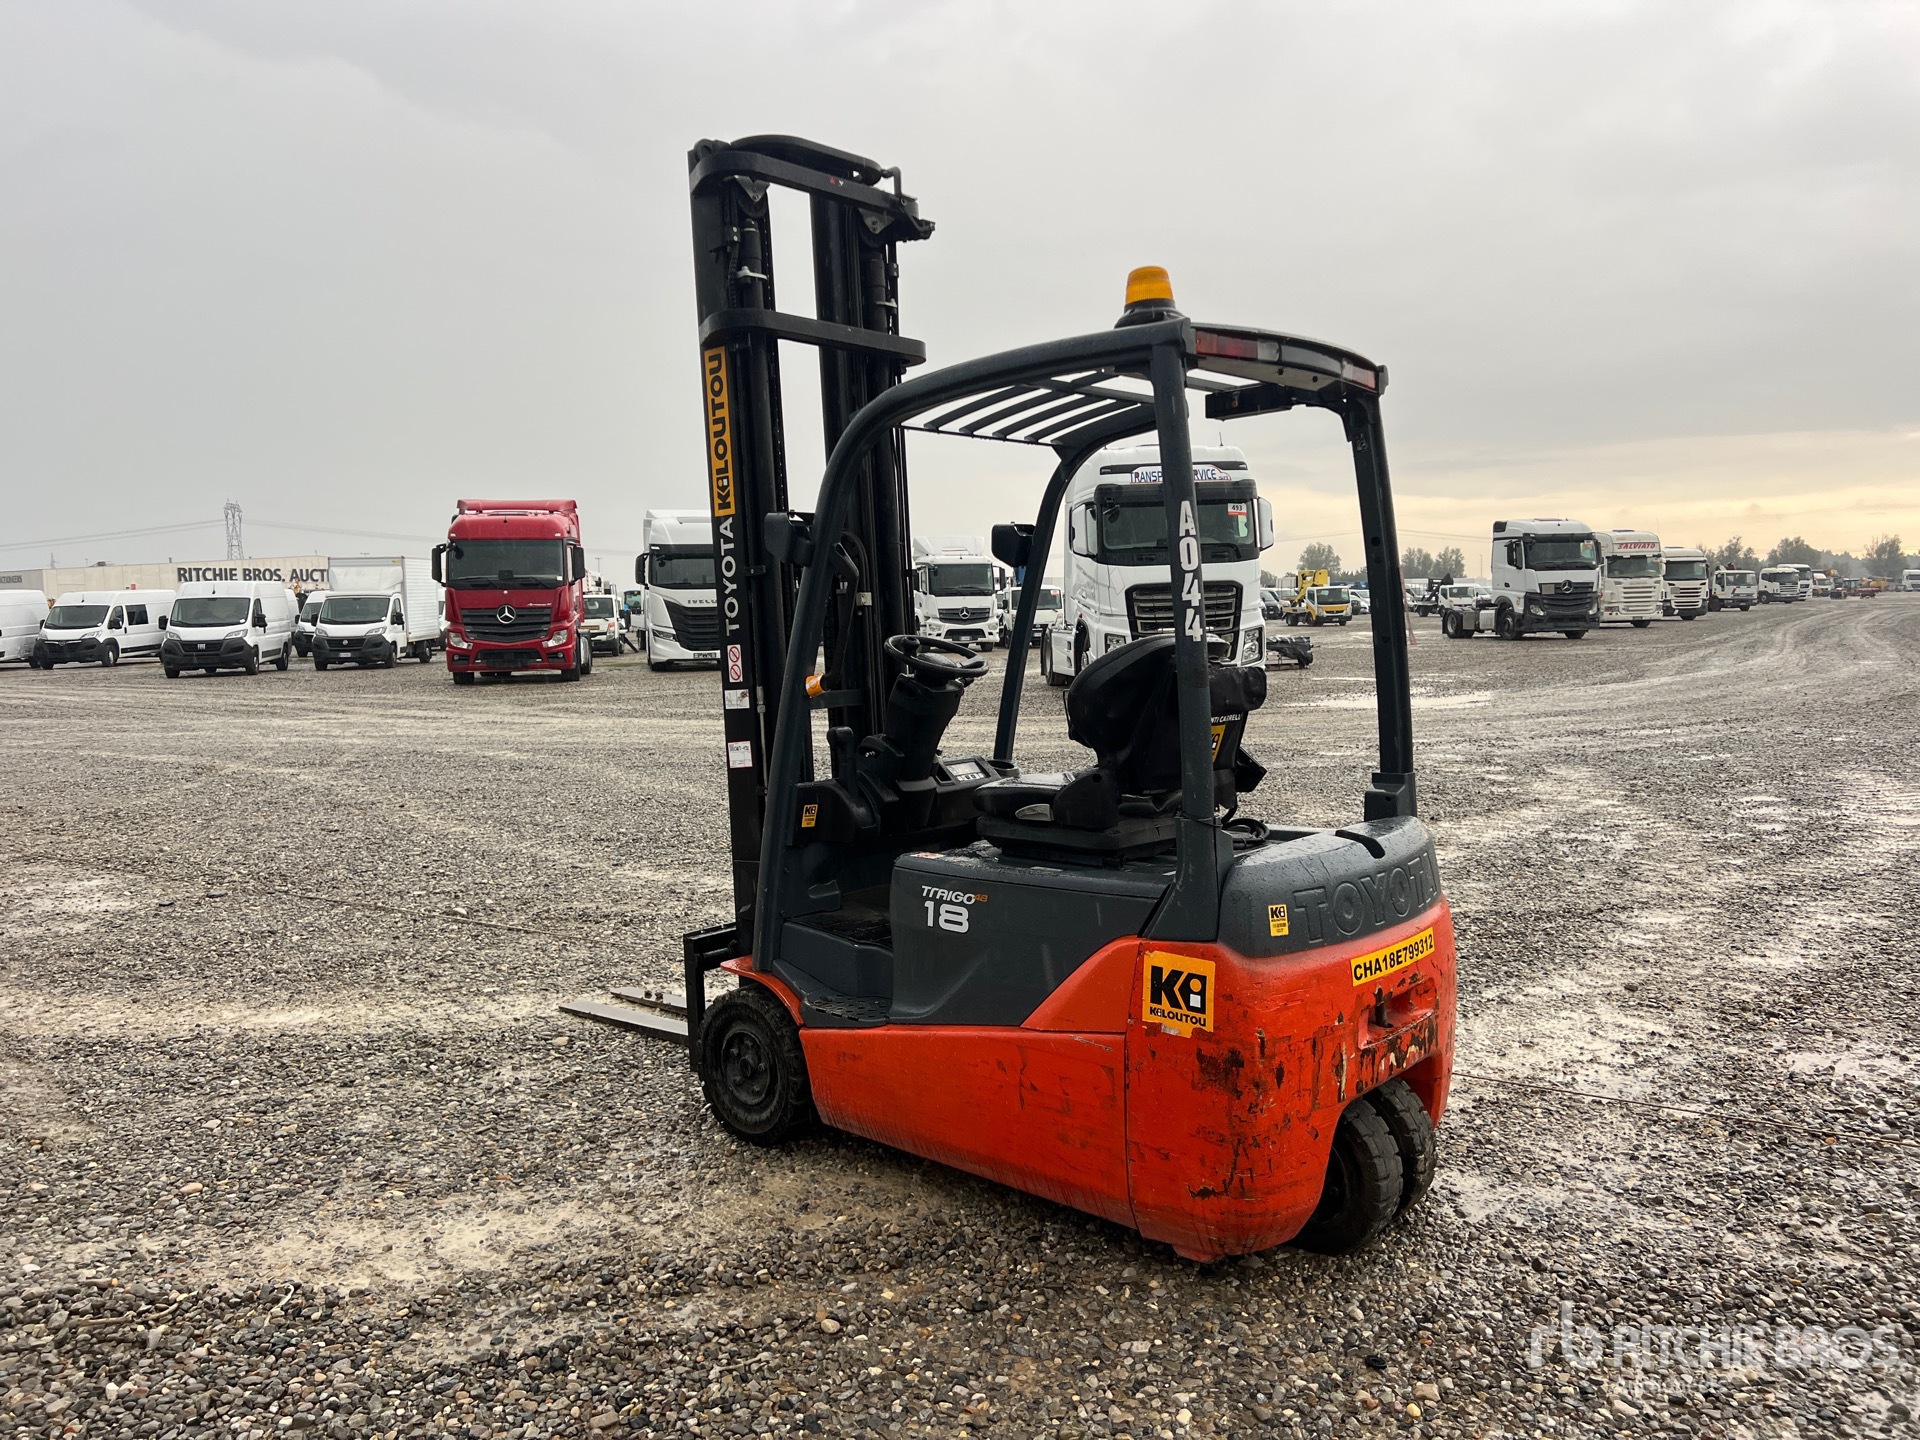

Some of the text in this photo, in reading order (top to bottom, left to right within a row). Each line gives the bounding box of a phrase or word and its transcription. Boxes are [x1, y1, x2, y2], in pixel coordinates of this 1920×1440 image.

[1130, 470, 1163, 484] TRANSP
[1194, 468, 1217, 480] RVICE
[177, 567, 238, 582] RITCHIE
[242, 568, 286, 582] BROS.
[720, 516, 740, 637] TOYOTA
[924, 900, 969, 933] 18
[1353, 935, 1434, 981] CHA18E799312
